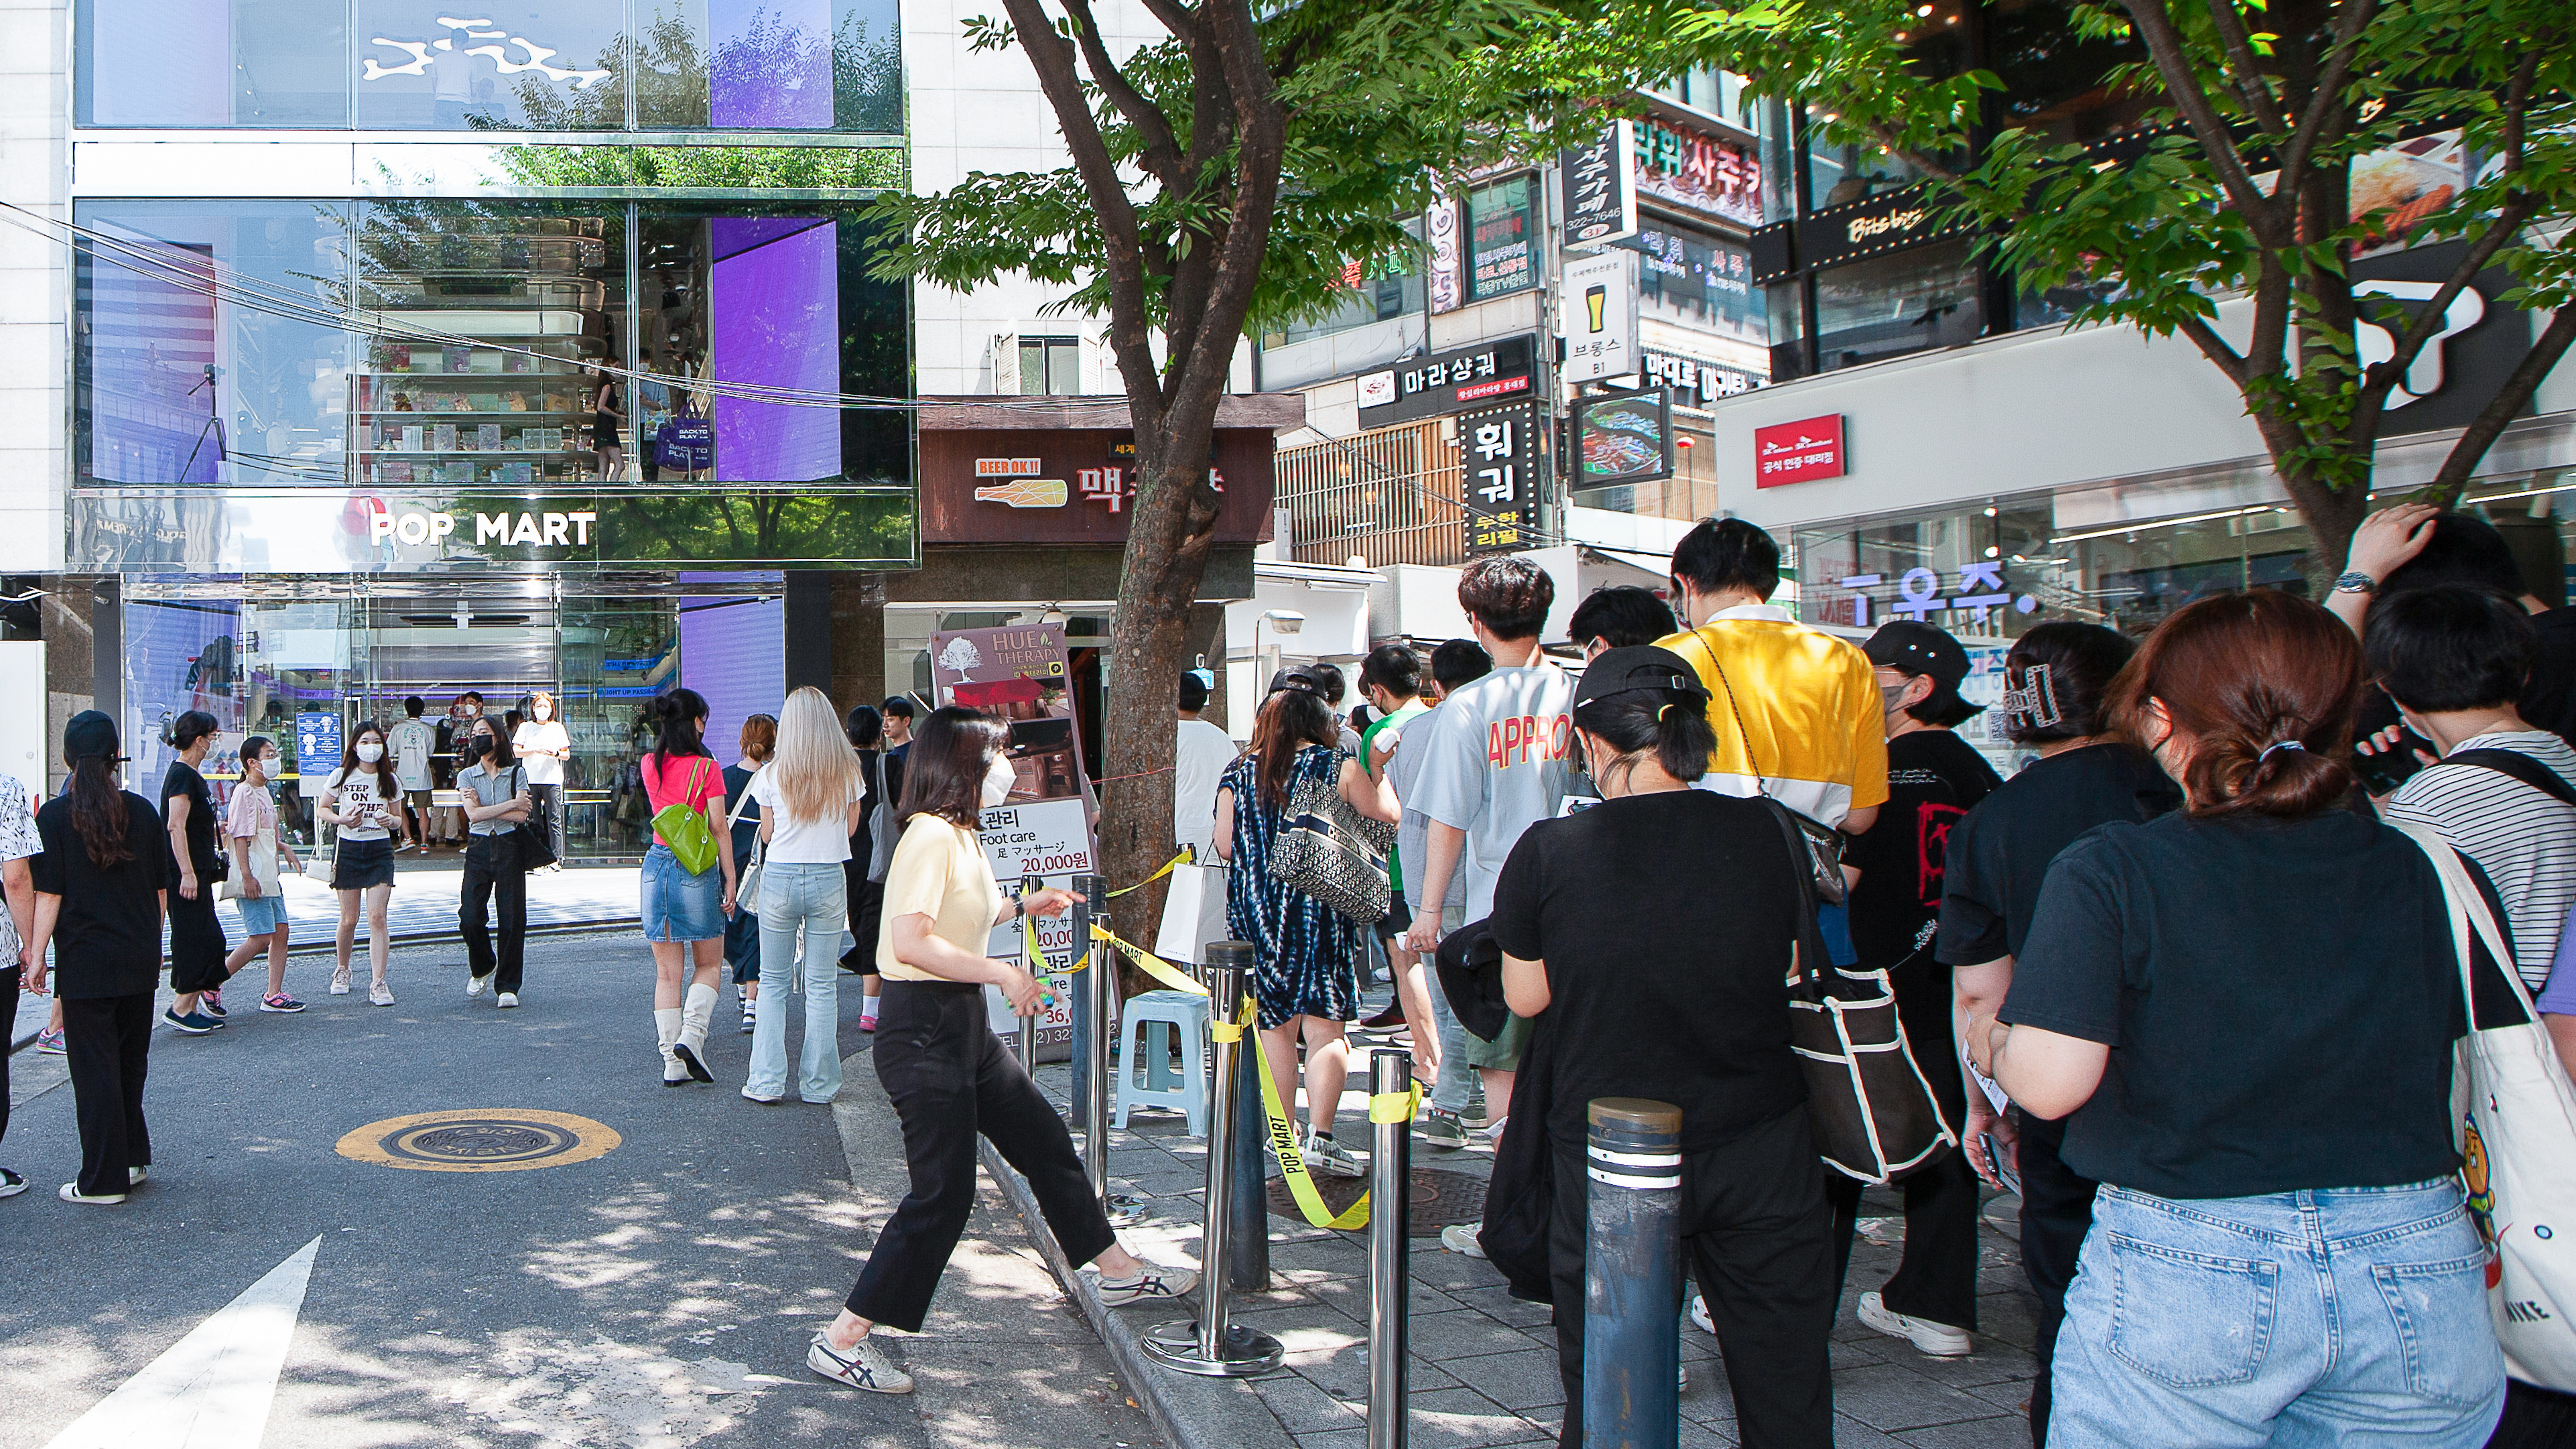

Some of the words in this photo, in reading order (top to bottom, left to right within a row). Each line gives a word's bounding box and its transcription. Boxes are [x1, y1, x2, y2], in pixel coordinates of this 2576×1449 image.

[1567, 207, 1622, 231] 322-7646
[1584, 225, 1605, 238] 3F
[1573, 338, 1622, 357] 브롱스
[1405, 351, 1495, 394] 마라샹궈
[980, 460, 1009, 474] BEER
[1475, 420, 1515, 503] 훠궈
[1763, 461, 1783, 475] 공식
[1783, 456, 1803, 471] 인증
[1804, 451, 1834, 465] 대리점
[370, 512, 456, 546] POP
[475, 512, 596, 547] MART
[992, 631, 1038, 651] HUE
[996, 648, 1061, 665] THERAPY
[1488, 713, 1572, 771] APPRO
[343, 784, 369, 792] STEP
[351, 793, 369, 802] ON
[978, 833, 1009, 846] Foot
[1010, 832, 1036, 843] care
[997, 848, 1009, 859] 足
[1011, 840, 1066, 856] マッサージ
[1021, 850, 1088, 874] 20,000원
[1124, 944, 1143, 964] MART
[1269, 1115, 1295, 1149] MART
[1281, 1151, 1304, 1174] POP
